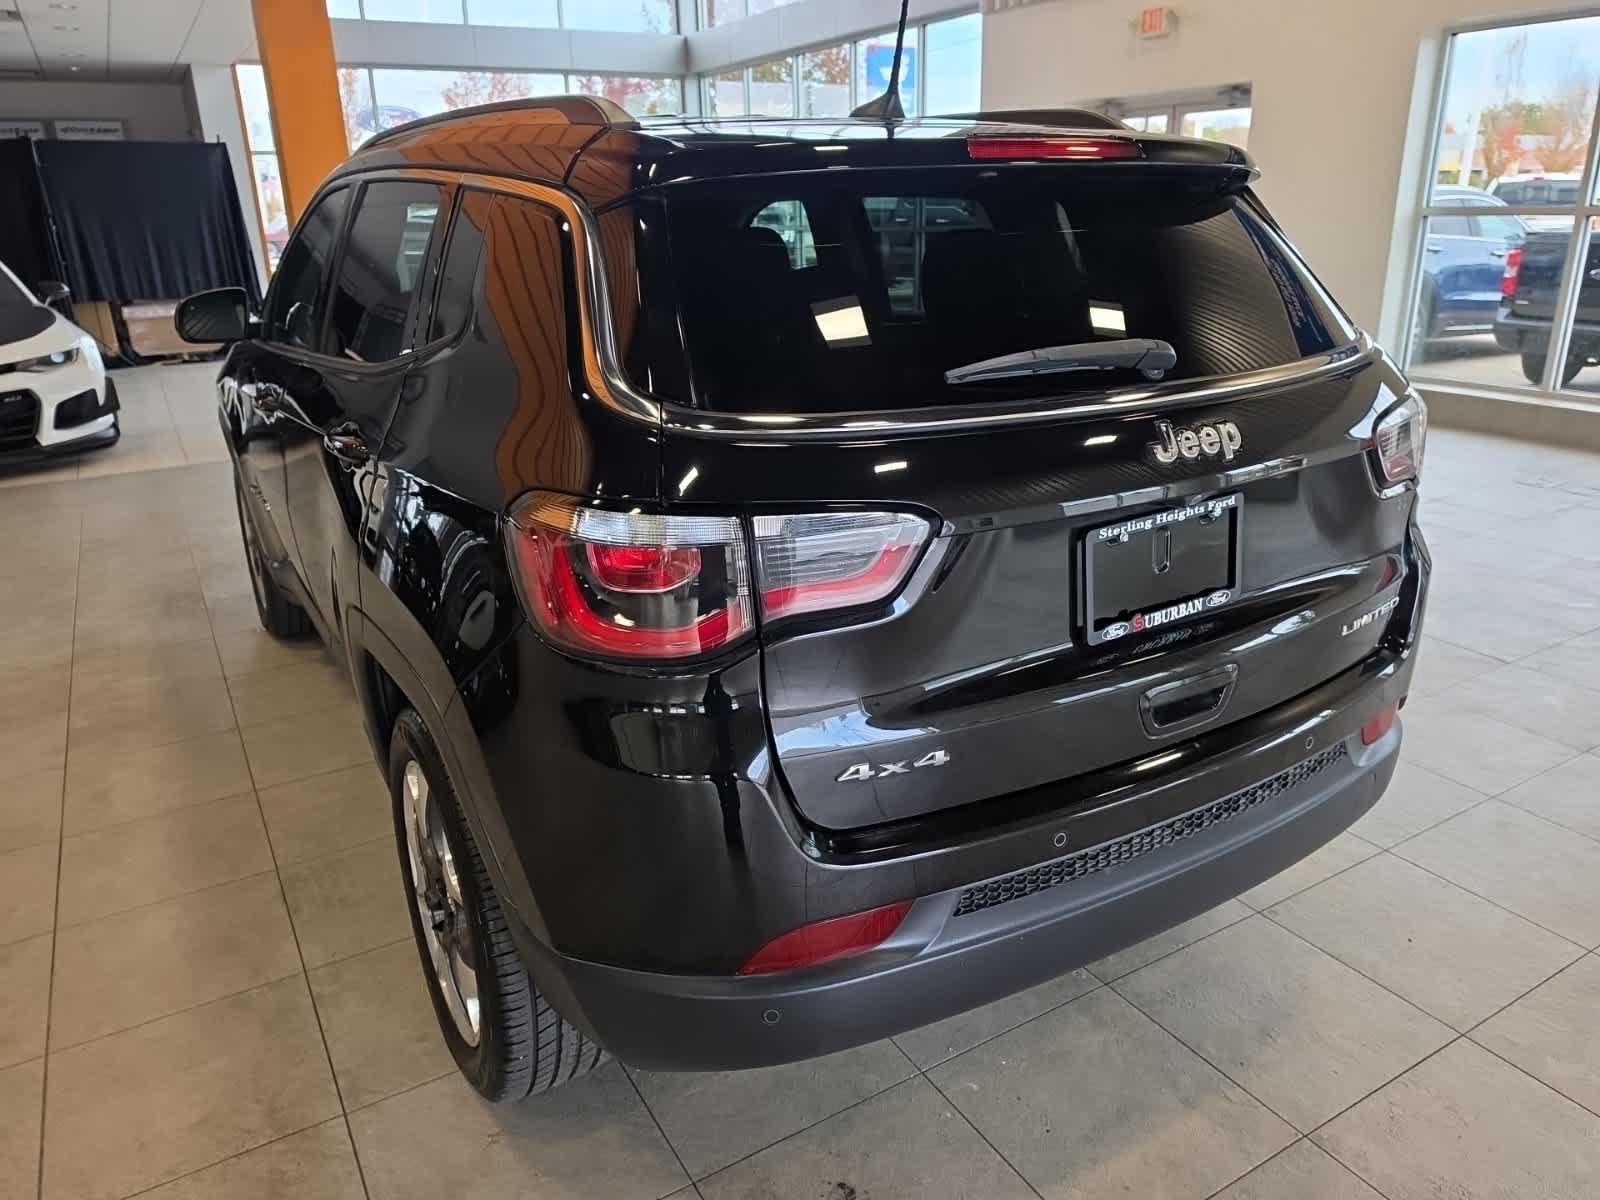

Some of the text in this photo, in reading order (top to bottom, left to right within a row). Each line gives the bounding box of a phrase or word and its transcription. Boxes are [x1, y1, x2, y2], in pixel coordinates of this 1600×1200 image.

[1151, 421, 1242, 462] Jeep
[1098, 496, 1236, 539] Sterling Heights Ford
[1132, 598, 1204, 632] SUBURBAN
[1341, 597, 1399, 636] LIMITED
